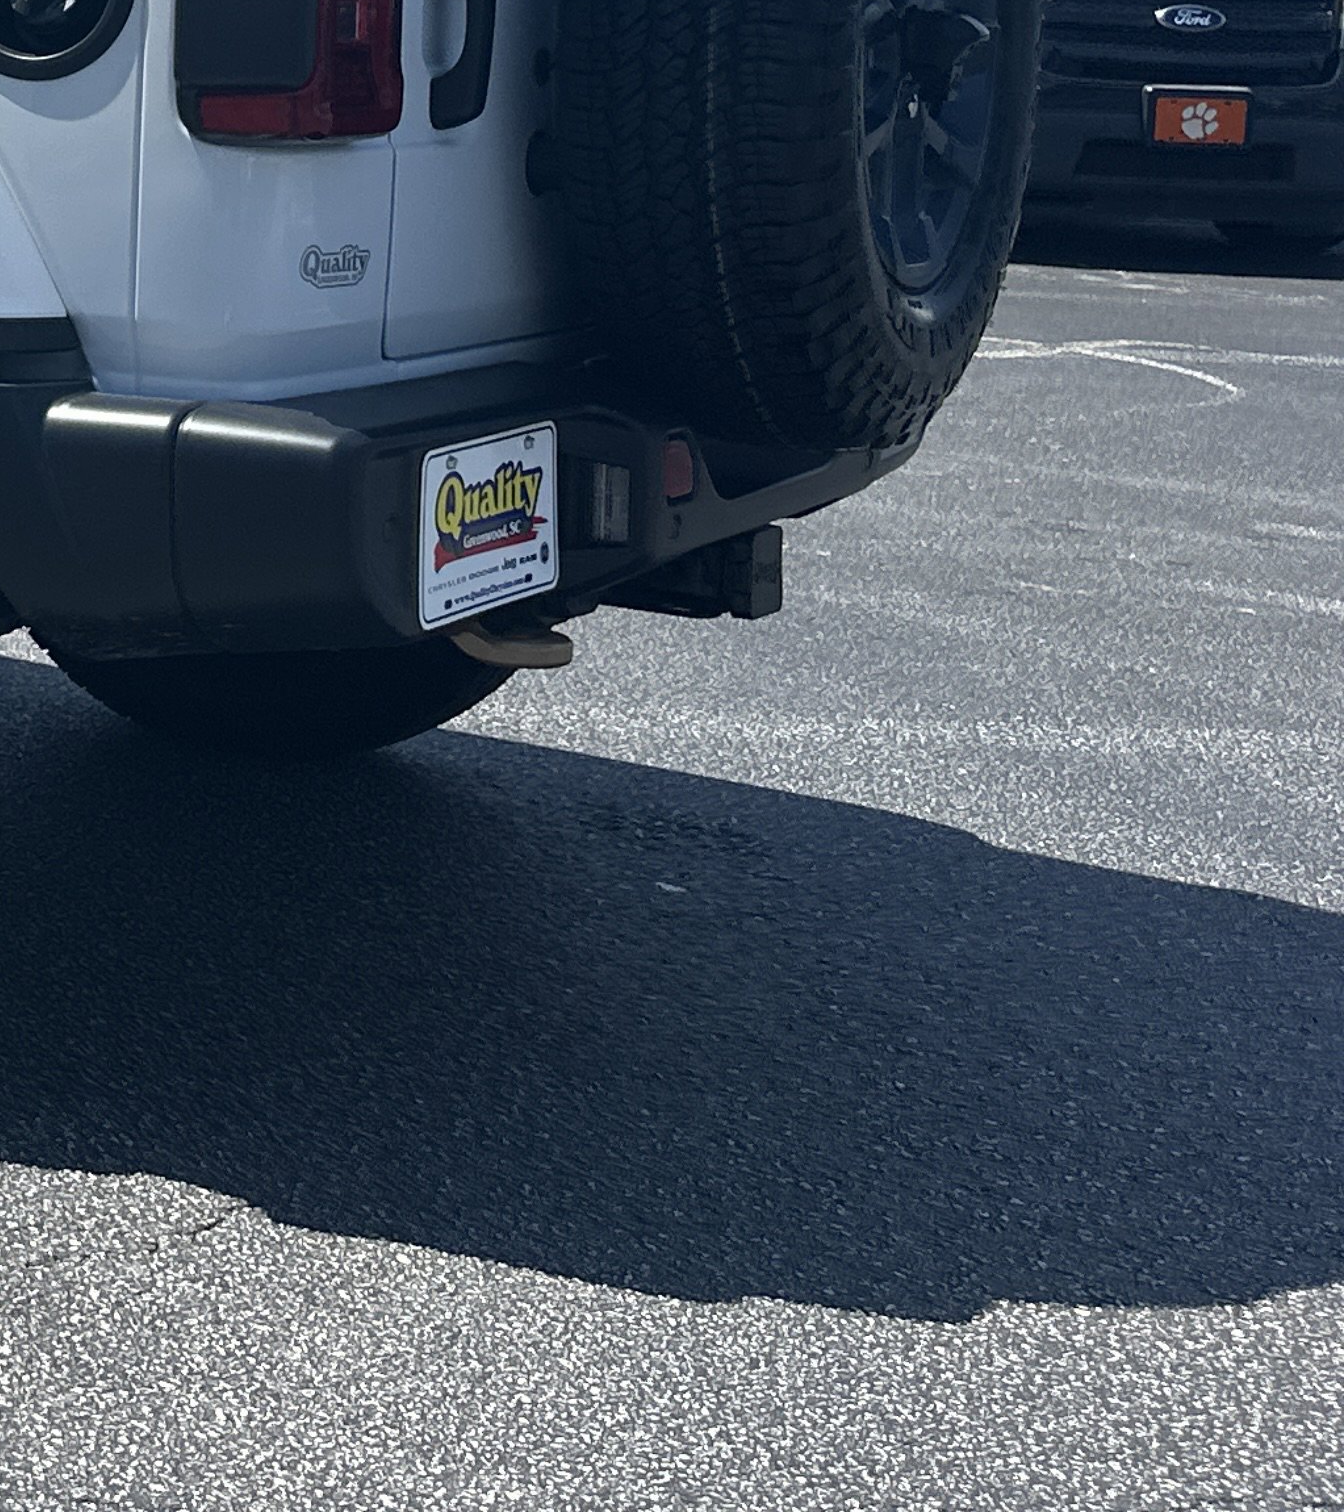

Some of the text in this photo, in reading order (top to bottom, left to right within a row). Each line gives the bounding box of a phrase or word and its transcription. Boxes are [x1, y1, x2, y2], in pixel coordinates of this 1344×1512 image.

[1173, 8, 1212, 27] Ford
[302, 249, 369, 282] Quality
[435, 464, 542, 541] Quality
[509, 519, 522, 536] SC
